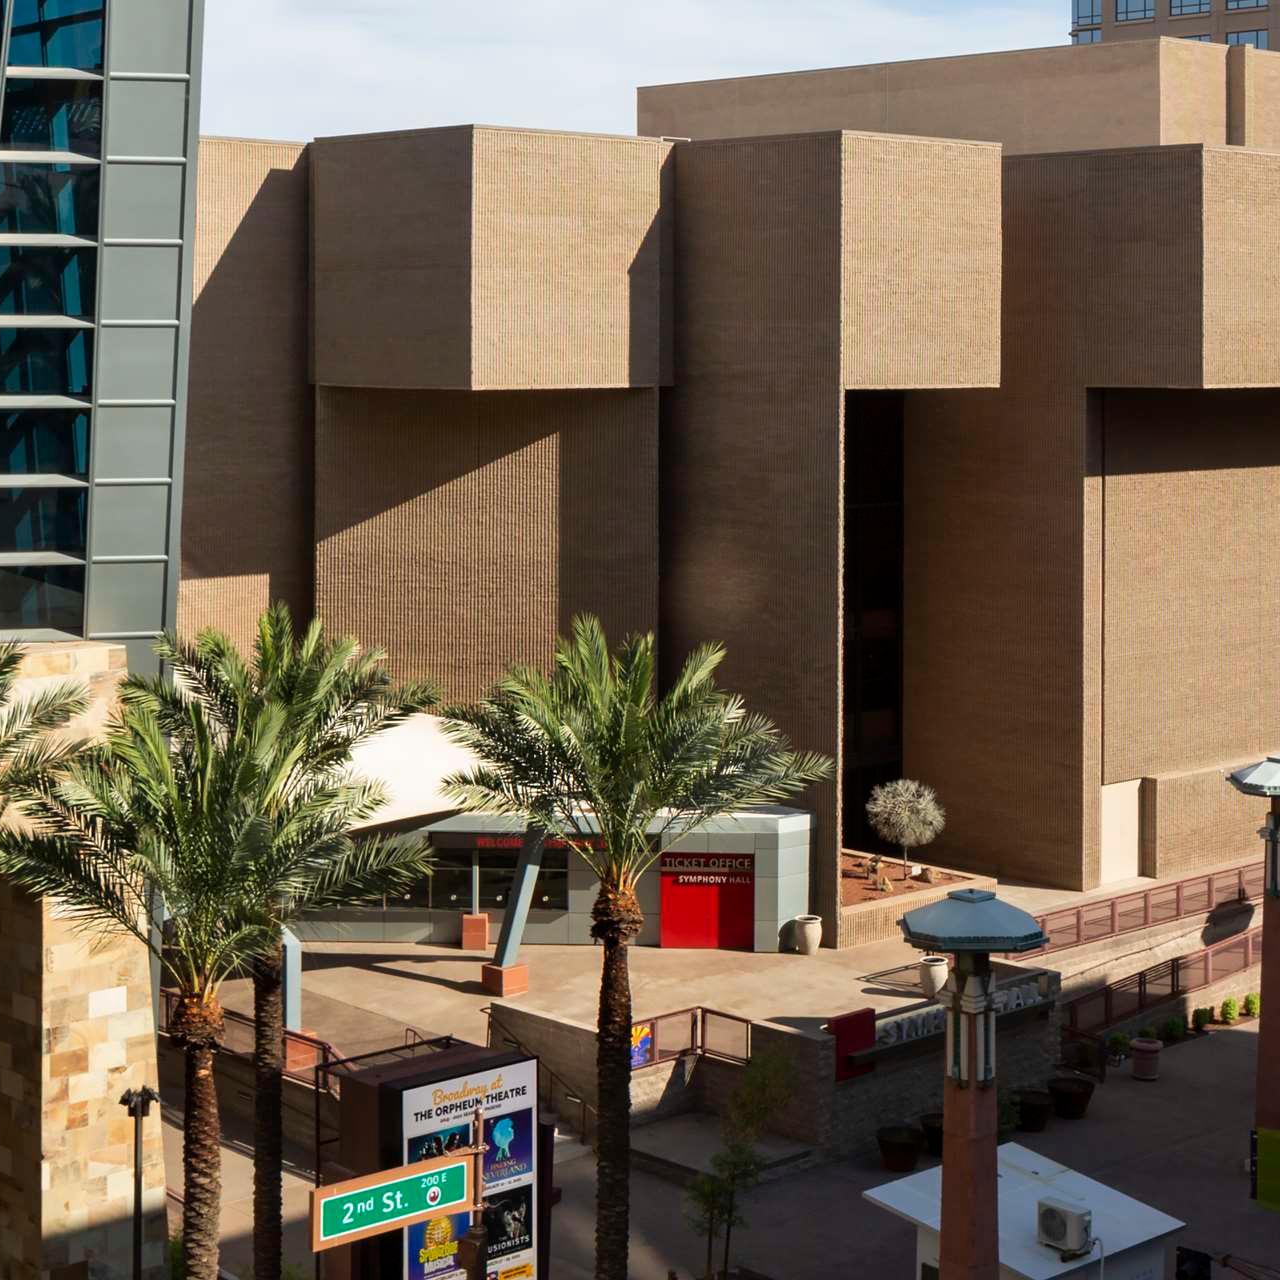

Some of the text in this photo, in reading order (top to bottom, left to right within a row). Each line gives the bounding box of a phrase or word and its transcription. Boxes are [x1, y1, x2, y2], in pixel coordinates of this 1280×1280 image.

[665, 857, 752, 869] TICKET OFFICE
[679, 874, 751, 884] SYMPHONY HALL
[431, 1073, 504, 1106] Broadway at
[413, 1108, 433, 1123] THE
[434, 1098, 483, 1118] ORPHEUM
[485, 1085, 527, 1105] THEATRE
[420, 1173, 447, 1188] 200 E
[342, 1190, 409, 1224] 2nd St.
[488, 1234, 530, 1254] USIONISTS
